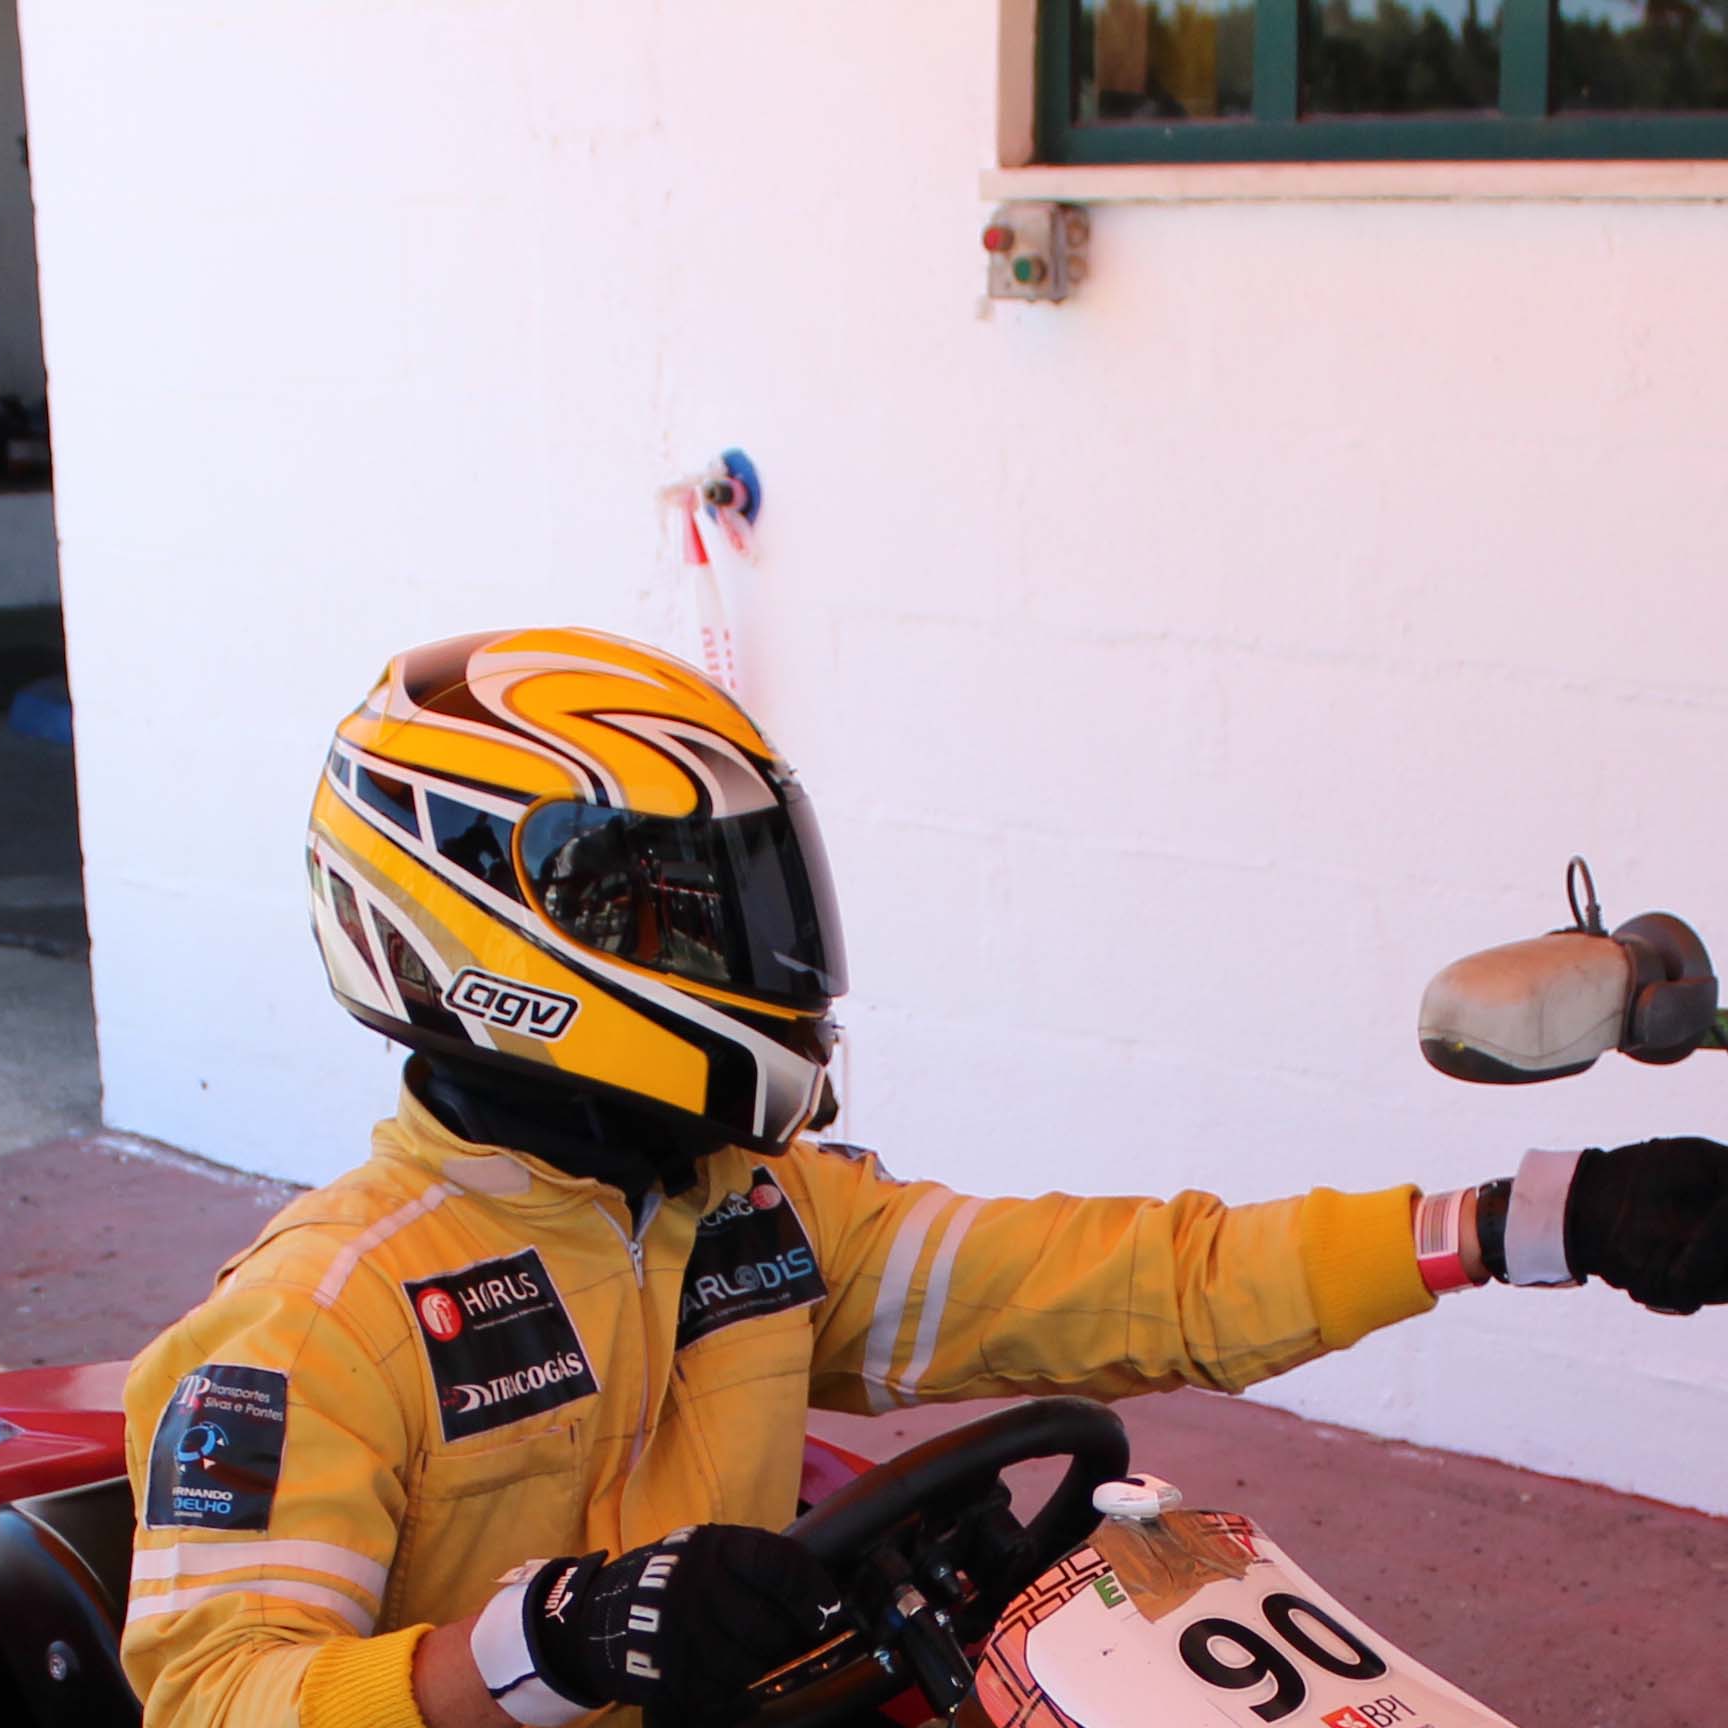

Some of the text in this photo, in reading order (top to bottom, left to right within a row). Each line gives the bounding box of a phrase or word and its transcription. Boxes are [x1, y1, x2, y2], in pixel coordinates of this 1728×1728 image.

[462, 981, 561, 1028] agv
[244, 1402, 284, 1422] Pontes
[1178, 1592, 1388, 1724] 90
[1358, 1694, 1417, 1728] BPI
